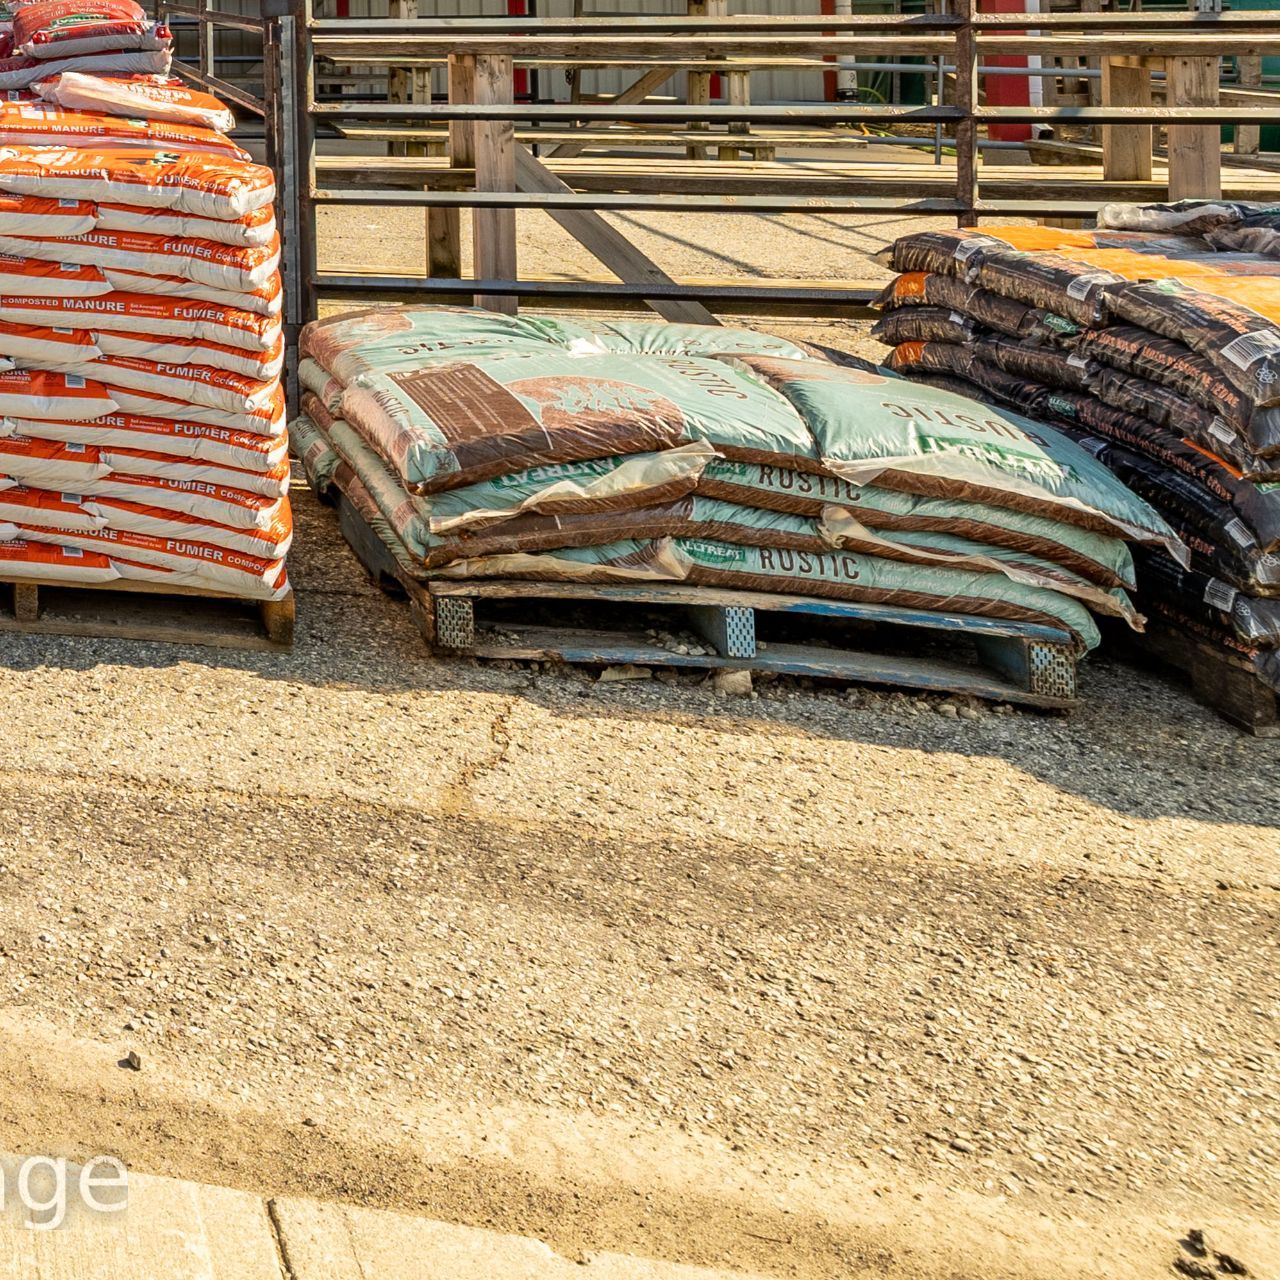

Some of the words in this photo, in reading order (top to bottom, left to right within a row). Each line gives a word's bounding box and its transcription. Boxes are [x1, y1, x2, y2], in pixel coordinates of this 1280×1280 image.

[51, 124, 105, 135] MANURE
[147, 129, 196, 142] FUMIER
[2, 297, 59, 306] COMPOSTED
[62, 299, 125, 312] MANURE
[174, 308, 225, 321] FUMIER
[156, 363, 211, 381] FUMIER
[656, 358, 748, 401] RUSTIC
[174, 424, 230, 440] FUMIER
[880, 402, 1051, 448] RUSTIC
[160, 479, 216, 495] FUMIER
[759, 465, 862, 502] RUSTIC
[166, 540, 224, 561] FUMIER
[759, 548, 860, 580] RUSTIC
